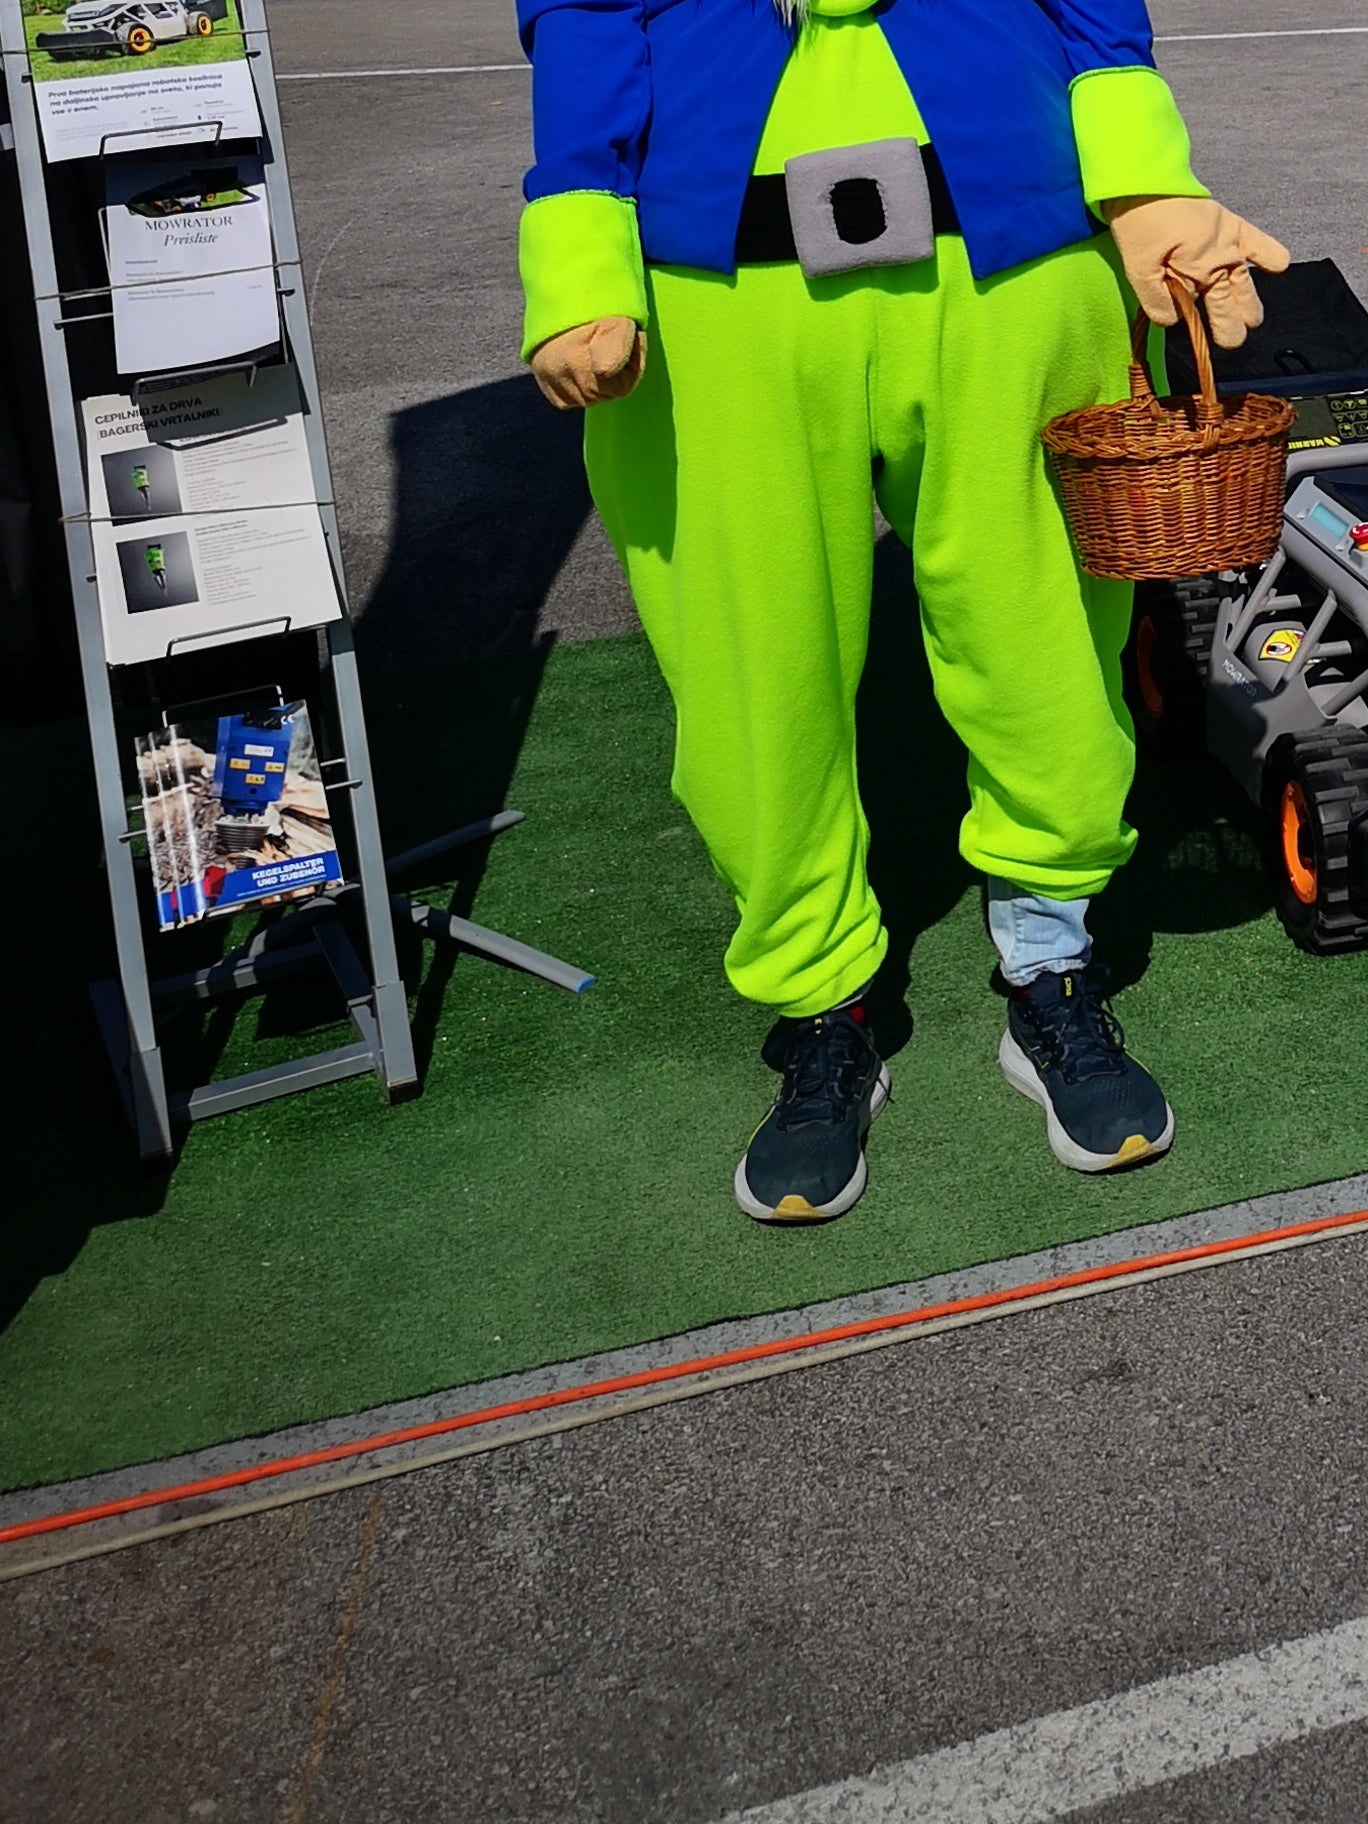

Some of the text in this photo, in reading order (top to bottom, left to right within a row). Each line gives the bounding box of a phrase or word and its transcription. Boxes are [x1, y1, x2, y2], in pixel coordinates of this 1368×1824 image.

[145, 216, 232, 231] MOWRATOR
[164, 233, 219, 246] Preisliste
[152, 402, 168, 414] ZA
[169, 397, 203, 411] DRVA
[99, 409, 220, 439] BAGERSKI VRTALNIKI
[252, 857, 324, 880] KEGELSPALTER
[257, 875, 278, 888] UND
[280, 865, 325, 883] ZUBEHÖR
